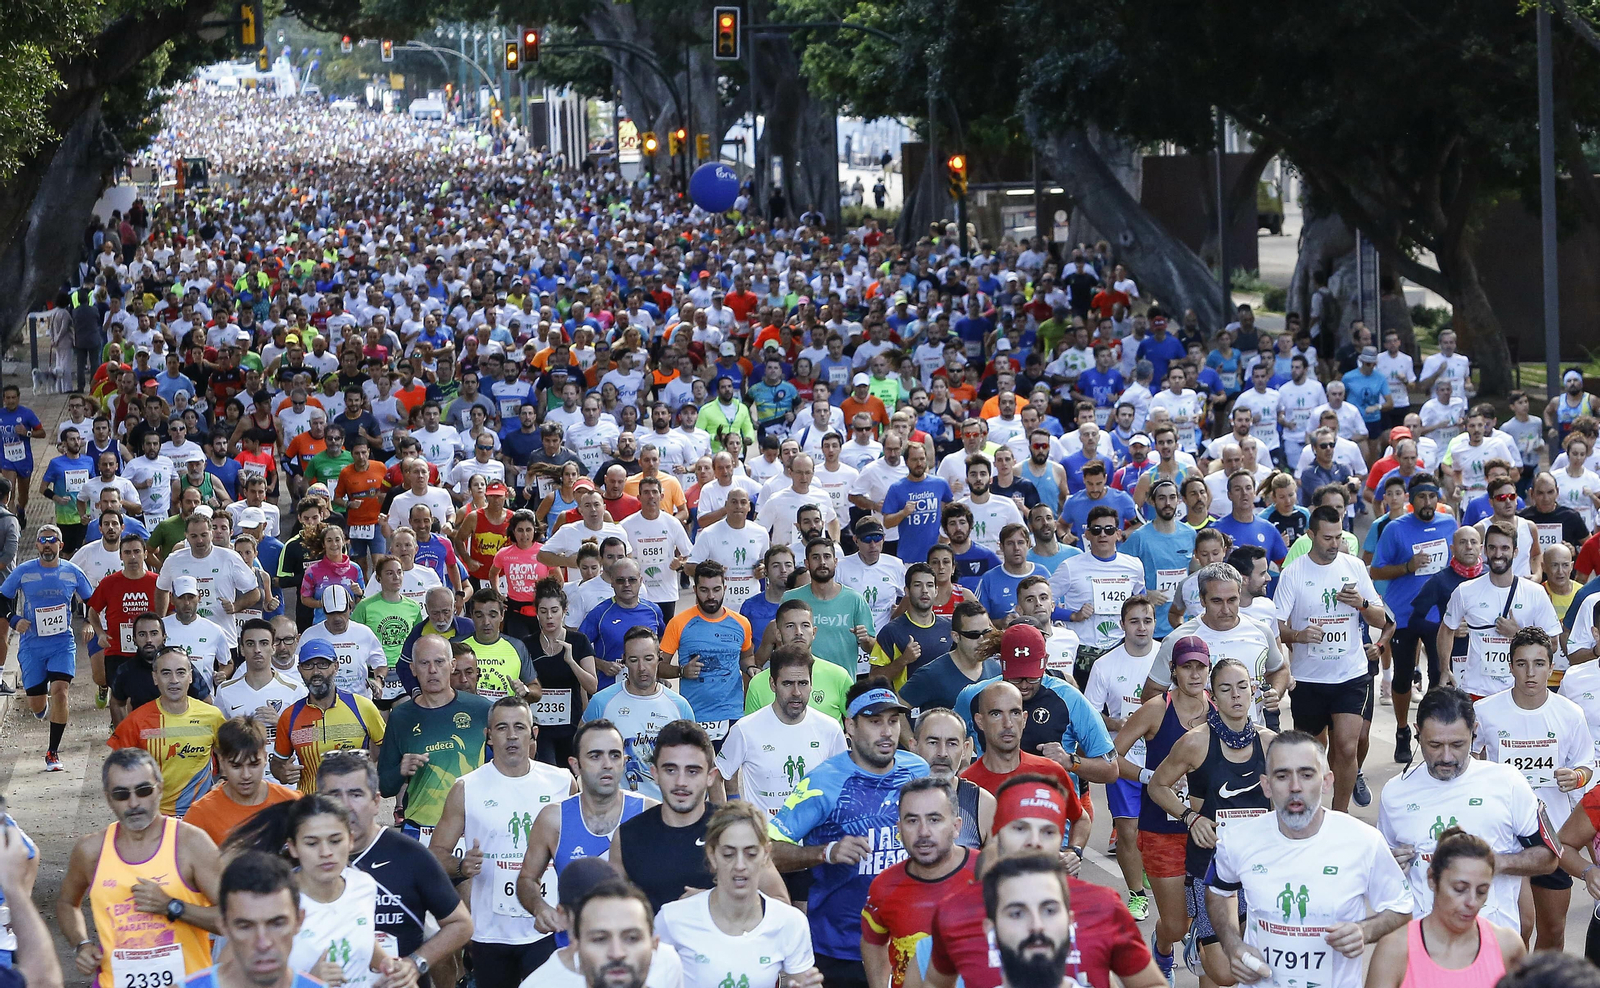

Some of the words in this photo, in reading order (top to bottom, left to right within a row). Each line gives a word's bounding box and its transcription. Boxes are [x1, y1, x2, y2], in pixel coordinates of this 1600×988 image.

[908, 491, 934, 500] Triatlón
[907, 512, 938, 525] 1873
[642, 548, 663, 556] 6581
[728, 586, 750, 594] 1885
[1100, 592, 1126, 601] 1426
[43, 616, 64, 626] 1242
[537, 702, 565, 712] 2336
[425, 741, 454, 752] cudeca
[1258, 919, 1269, 932] 41
[1263, 946, 1326, 970] 17917
[126, 970, 174, 988] 2339
